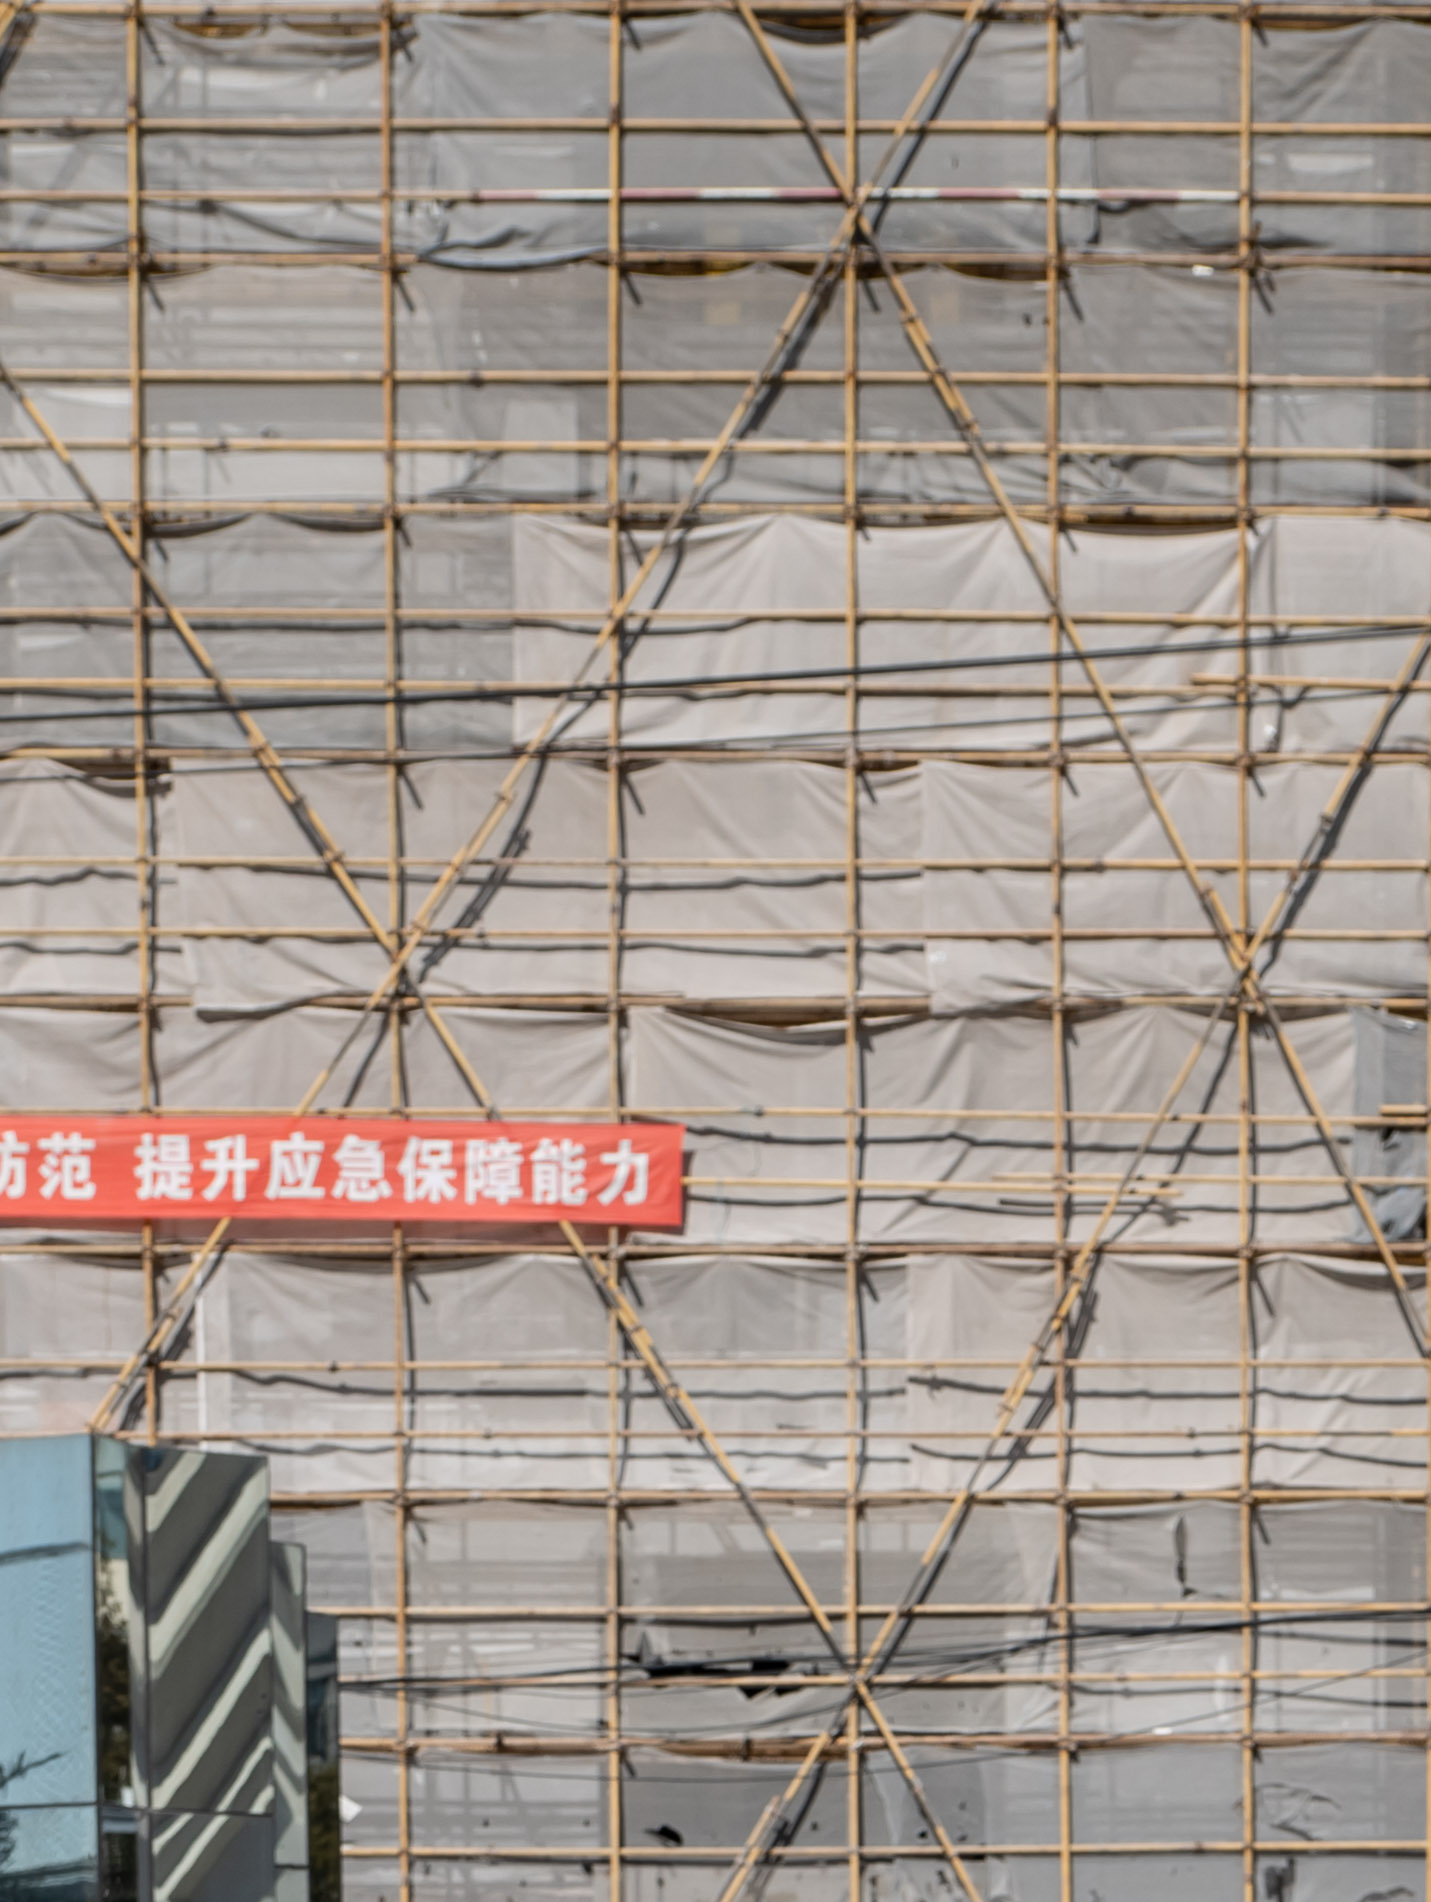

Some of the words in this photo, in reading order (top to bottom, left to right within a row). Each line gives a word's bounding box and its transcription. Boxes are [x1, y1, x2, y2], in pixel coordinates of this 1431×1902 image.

[133, 1130, 651, 1207] 提升应急保障能力
